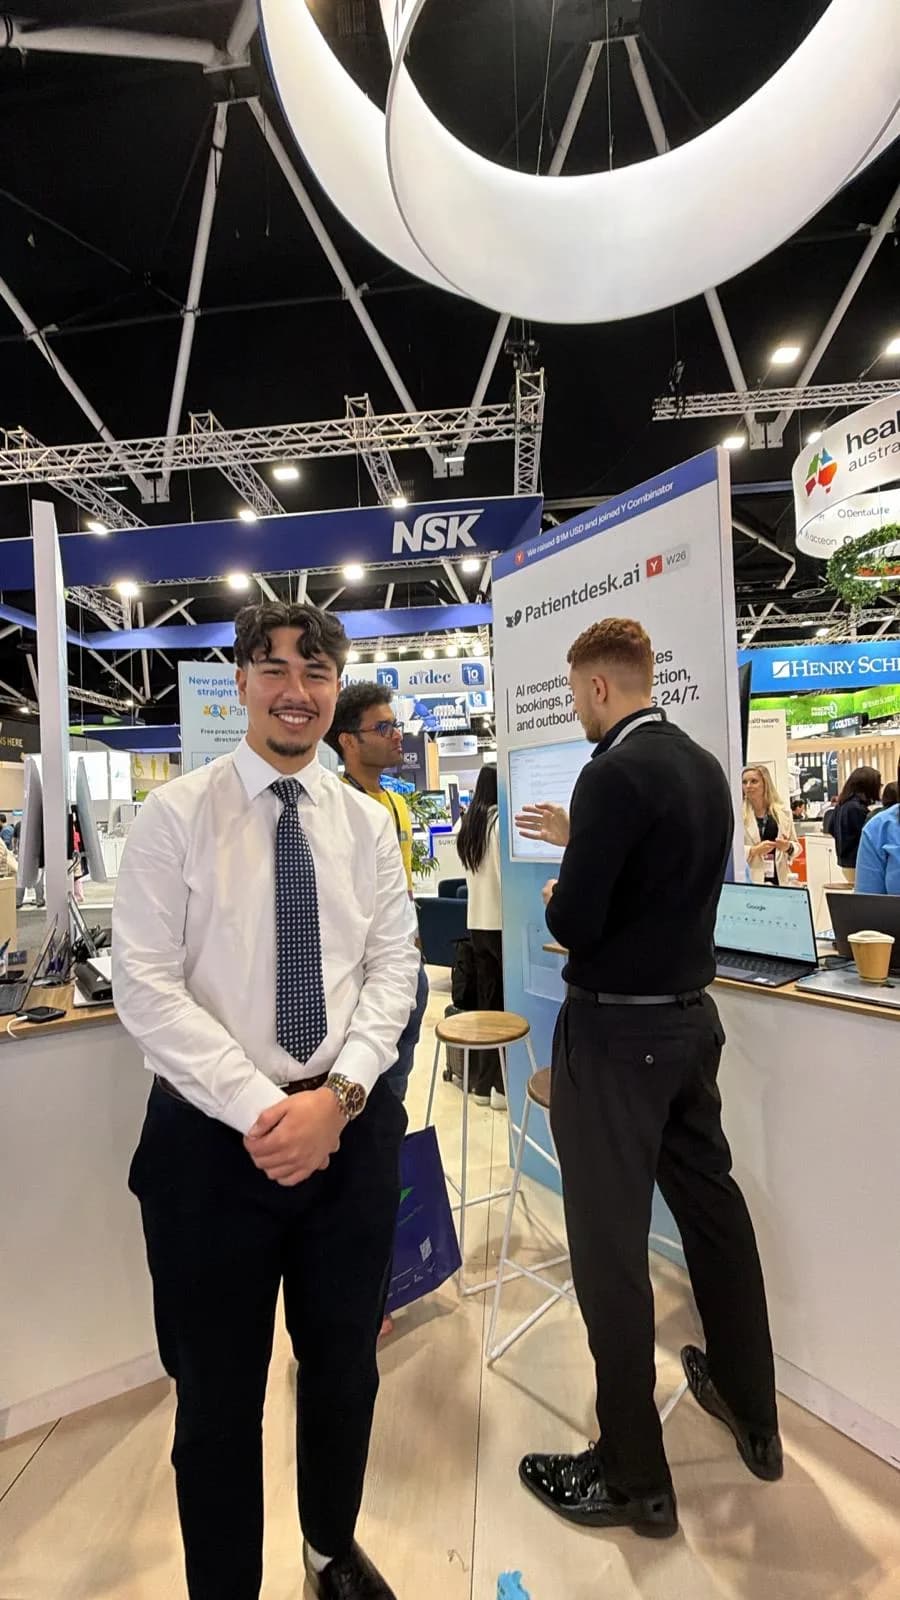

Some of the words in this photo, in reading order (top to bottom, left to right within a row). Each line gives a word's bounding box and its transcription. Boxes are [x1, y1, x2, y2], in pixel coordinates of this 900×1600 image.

[392, 508, 485, 554] NSK
[555, 531, 569, 545] $1M
[569, 525, 584, 539] USD
[585, 518, 598, 532] and
[598, 506, 620, 526] joined
[621, 503, 627, 515] Y
[627, 482, 675, 510] Combinator
[525, 563, 640, 623] Patientdesk.ai
[650, 560, 659, 572] Y
[666, 551, 687, 566] W26
[188, 676, 209, 685] New
[211, 677, 236, 686] patie
[515, 684, 525, 698] AI
[527, 674, 569, 694] receptio
[652, 650, 673, 664] es
[516, 696, 564, 714] bookings,
[652, 668, 691, 686] ction,
[791, 659, 855, 678] HENRY
[197, 687, 232, 698] straight
[229, 704, 247, 716] Pat
[516, 718, 535, 732] and
[536, 711, 580, 729] outboun
[661, 684, 700, 706] 24/7.
[7, 737, 24, 747] HERE
